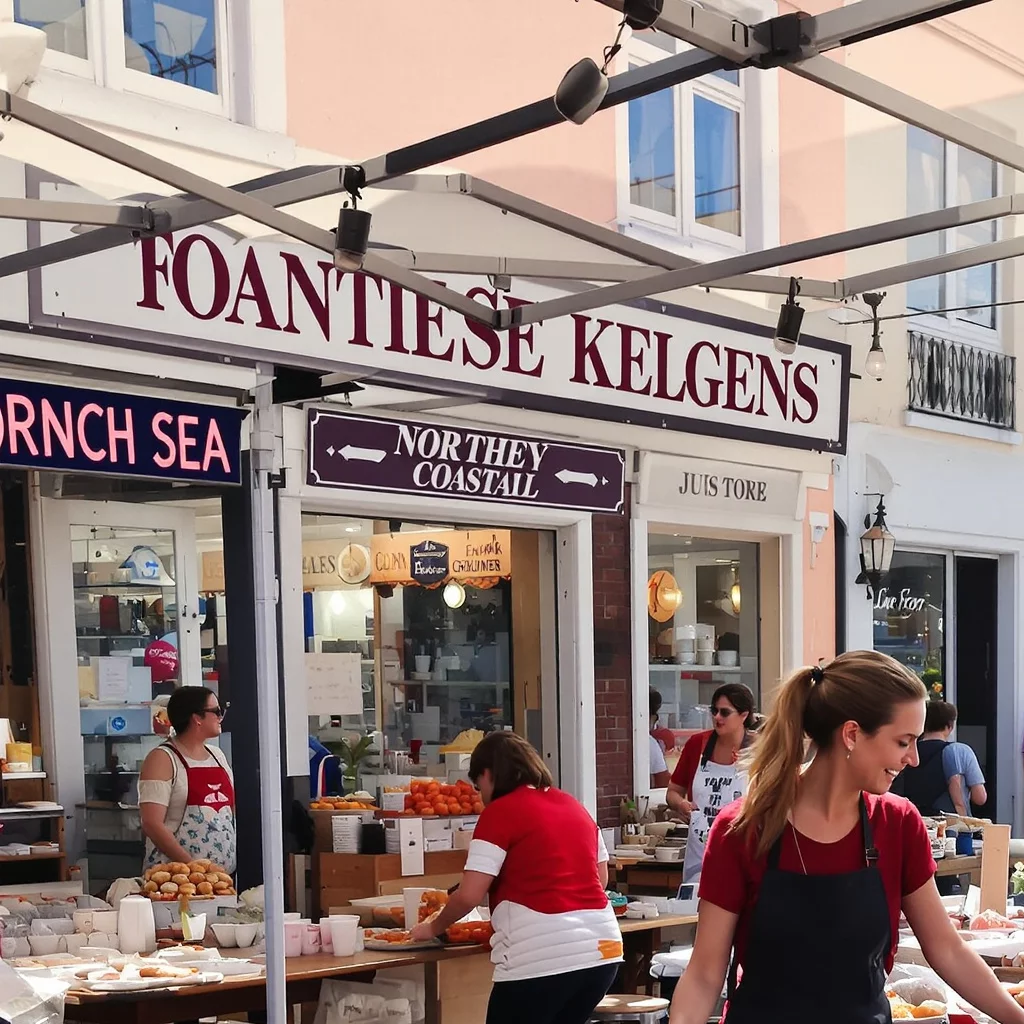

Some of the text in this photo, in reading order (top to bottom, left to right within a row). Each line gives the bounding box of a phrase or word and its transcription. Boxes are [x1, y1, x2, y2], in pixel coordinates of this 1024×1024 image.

[569, 313, 819, 424] KELGENS
[0, 393, 231, 473] RNCH SEA
